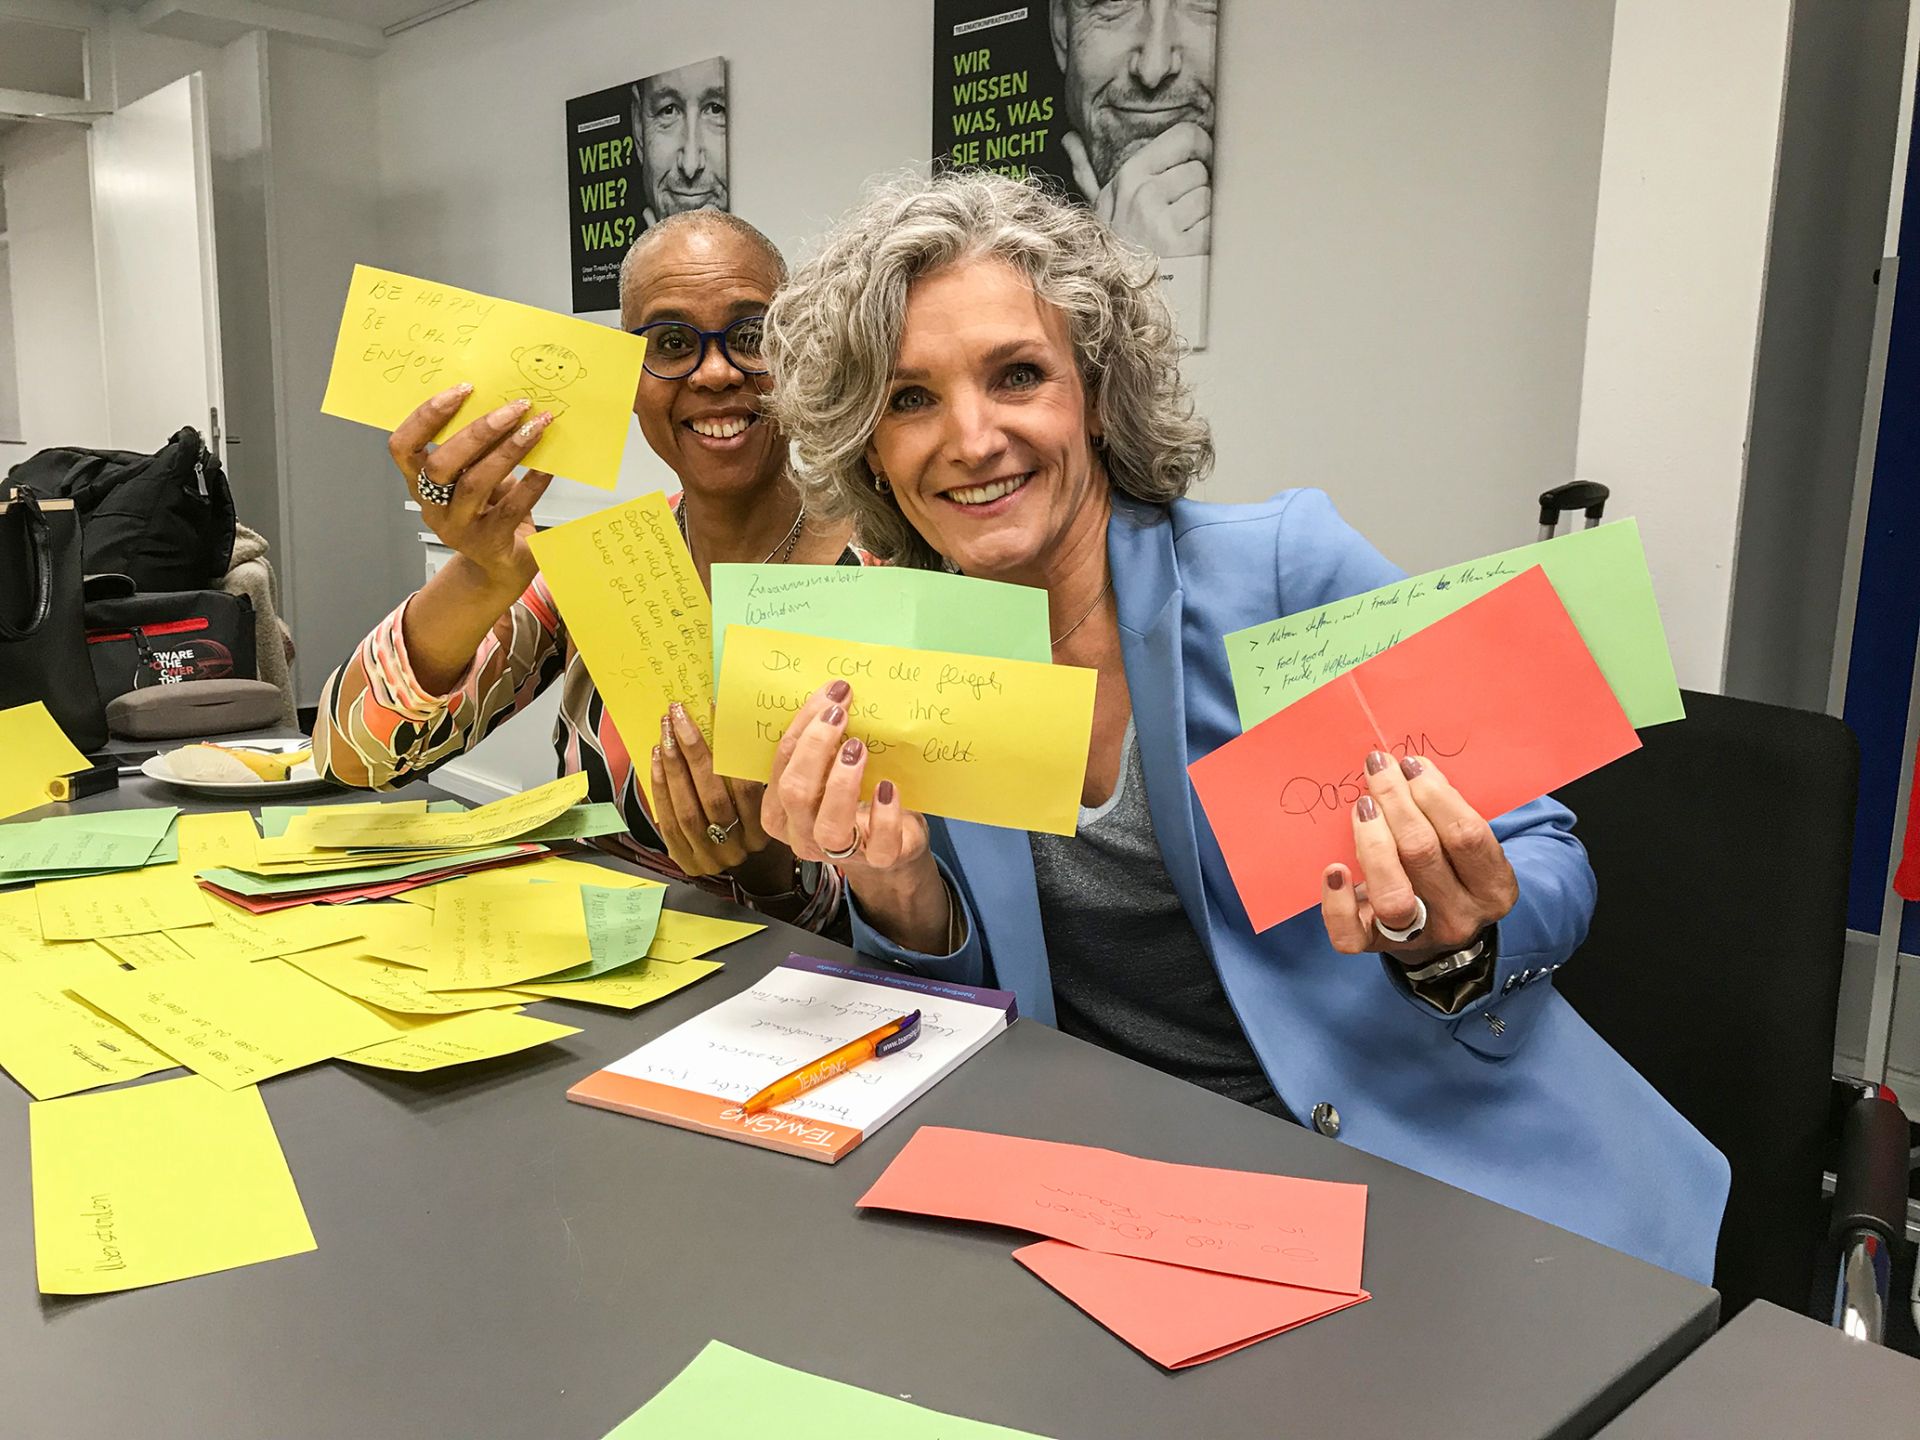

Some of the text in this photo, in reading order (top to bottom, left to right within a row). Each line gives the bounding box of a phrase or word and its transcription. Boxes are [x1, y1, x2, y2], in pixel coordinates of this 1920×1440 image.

[953, 48, 991, 77] WIR
[952, 70, 1028, 106] WISSEN
[952, 96, 1054, 136] WAS, WAS
[578, 135, 634, 175] WER?
[952, 129, 1049, 167] SIE NICHT
[579, 178, 629, 213] WIE?
[581, 215, 637, 252] WAS?
[368, 280, 496, 334] BE HAPPY
[361, 307, 472, 347] BE CALM
[763, 650, 801, 672] Die
[826, 656, 873, 678] CGM
[888, 661, 921, 682] die
[909, 698, 954, 725] ihre
